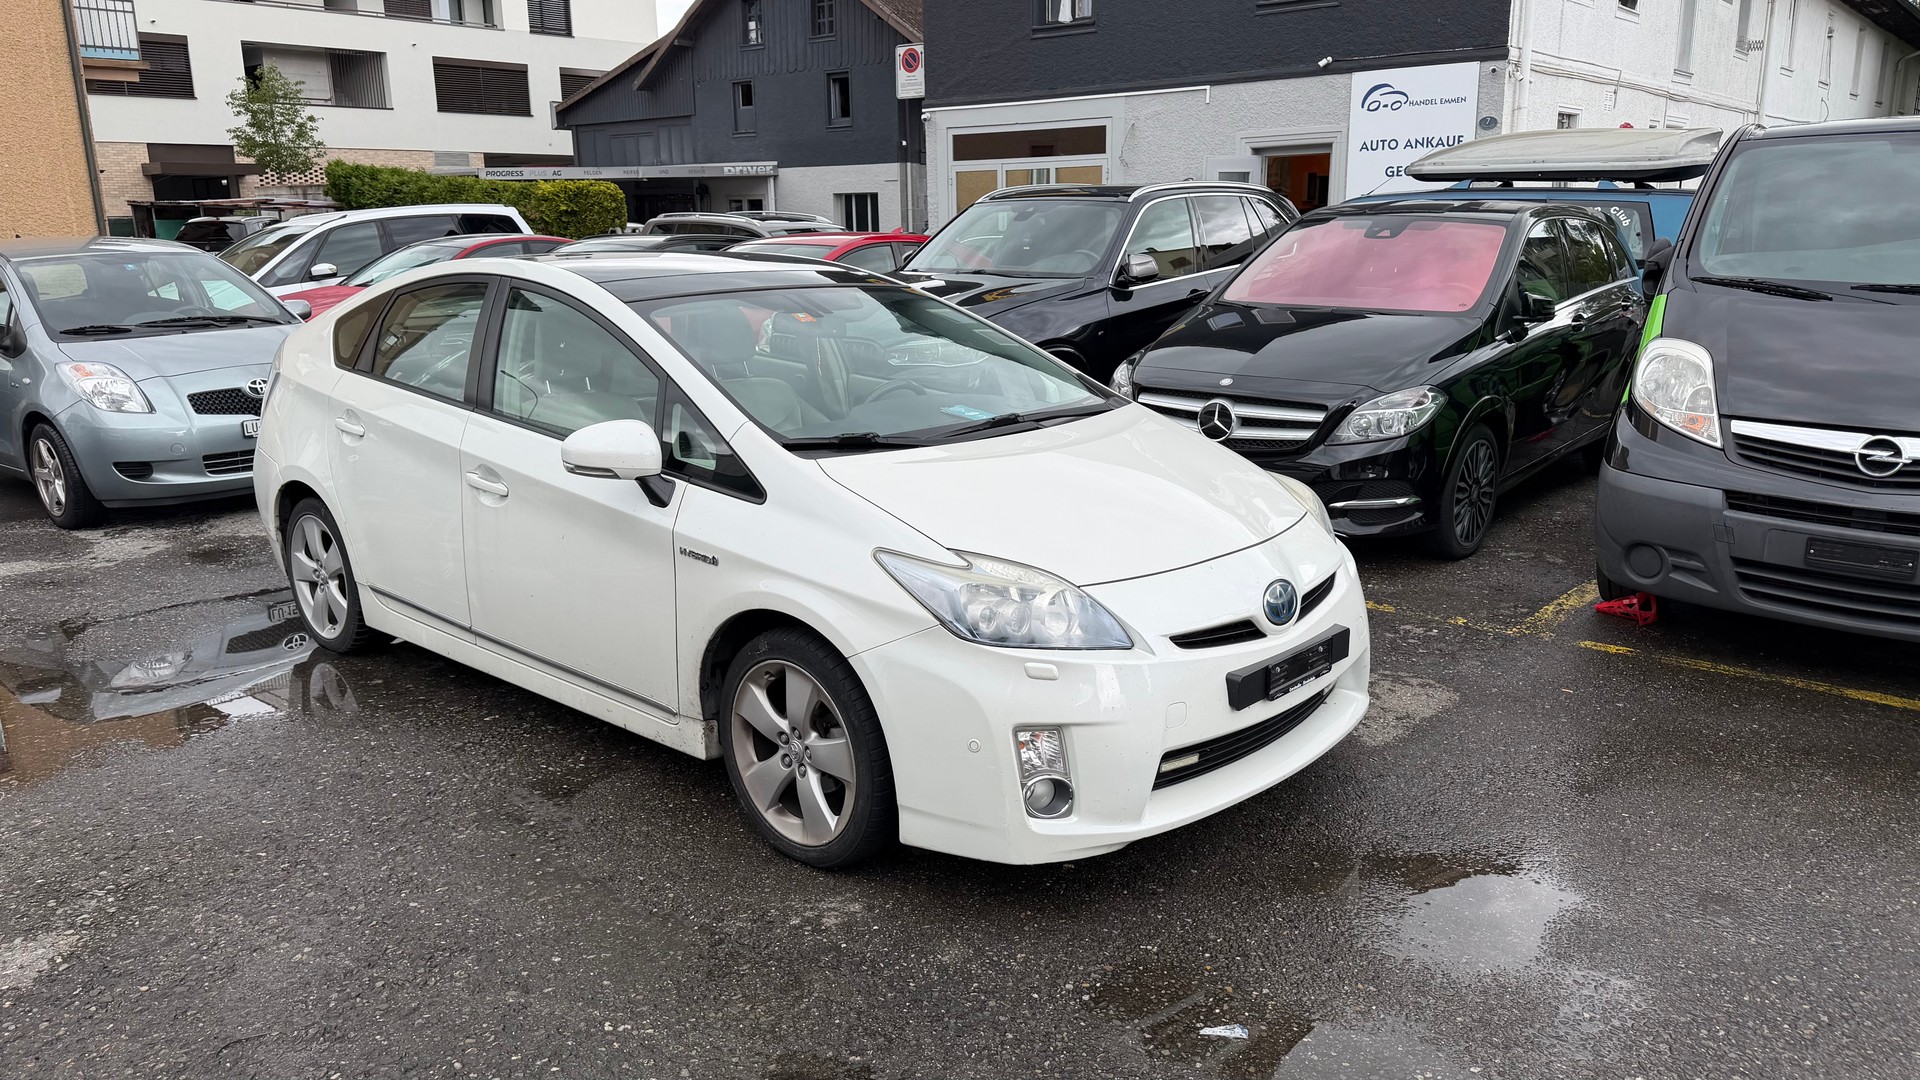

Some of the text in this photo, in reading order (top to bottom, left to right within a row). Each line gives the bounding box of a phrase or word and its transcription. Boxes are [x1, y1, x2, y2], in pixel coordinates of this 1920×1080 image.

[1408, 96, 1467, 106] HANDEL EMMEN
[1360, 135, 1464, 151] AUTO ANKAUF
[1610, 206, 1631, 226] Club
